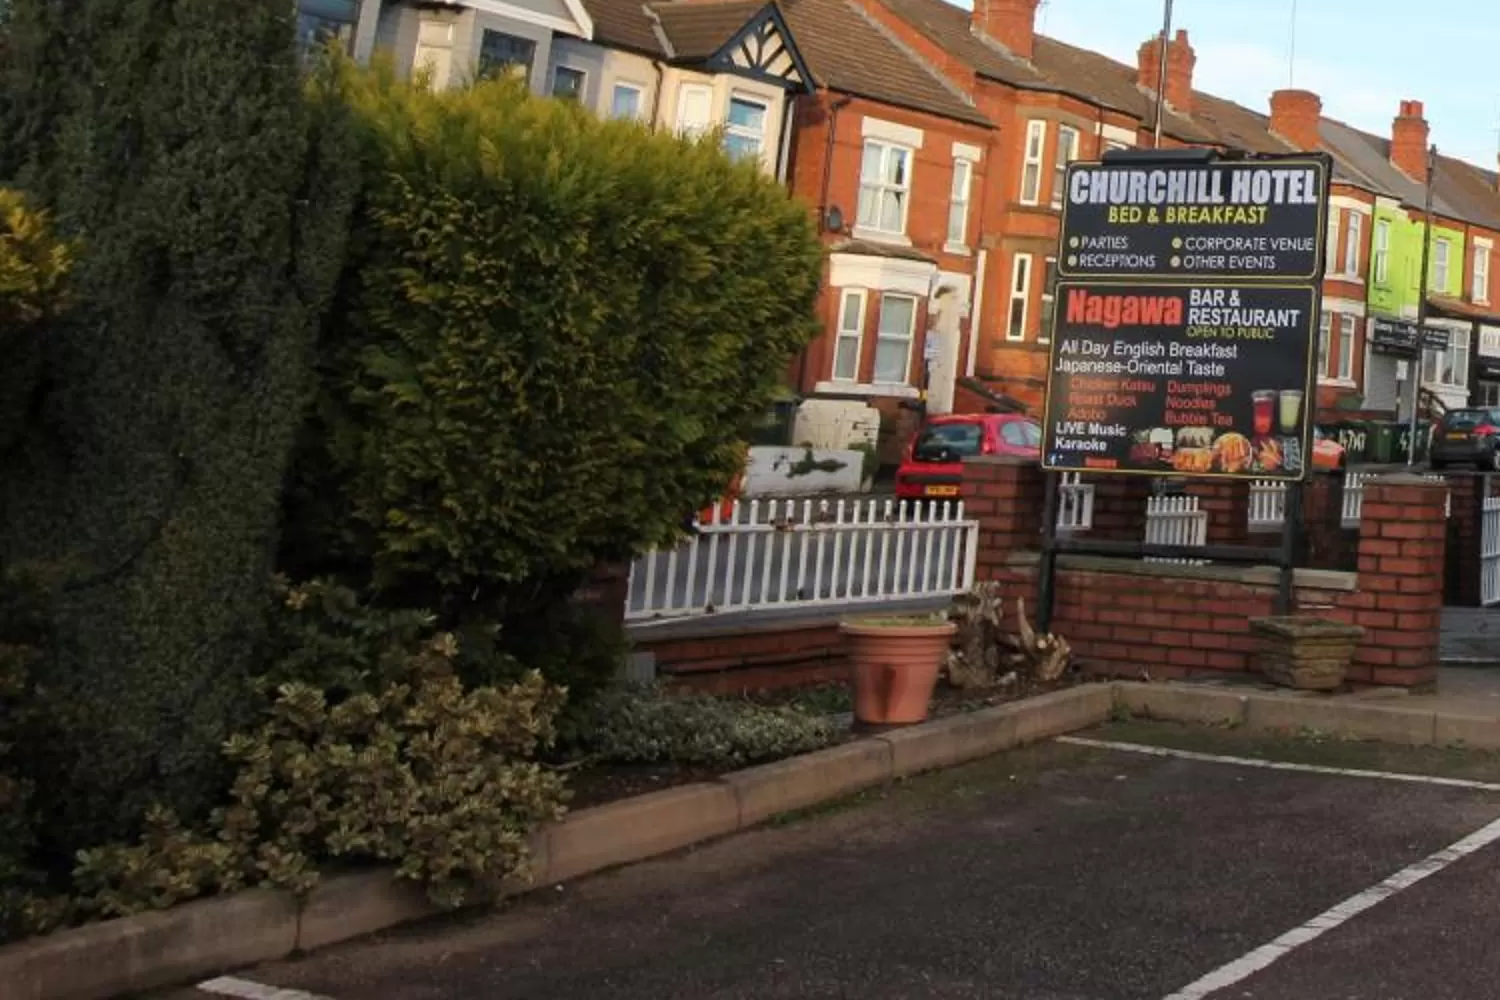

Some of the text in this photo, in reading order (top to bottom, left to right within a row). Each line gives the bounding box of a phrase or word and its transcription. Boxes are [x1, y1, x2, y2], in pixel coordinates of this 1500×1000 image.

[1069, 169, 1318, 205] CHURCHILL HOTEL
[1108, 206, 1268, 224] BED & BREAKFAST
[1081, 235, 1129, 249] PARTIES
[1184, 236, 1314, 250] CORPORATE VENUE
[1079, 254, 1156, 268] RECEPTIONS
[1183, 255, 1276, 268] OTHER EVENTS
[1189, 289, 1241, 307] BAR &
[1066, 289, 1184, 328] Nagawa
[1188, 308, 1301, 328] RESTAURANT
[1186, 327, 1217, 337] OPEN
[1237, 328, 1275, 339] PUBLIC
[1059, 339, 1238, 360] All Day English Breakfast
[1055, 358, 1225, 376] Japanese-Oriental Taste
[1055, 421, 1127, 437] LIVE Music
[1055, 436, 1108, 451] Karaoke
